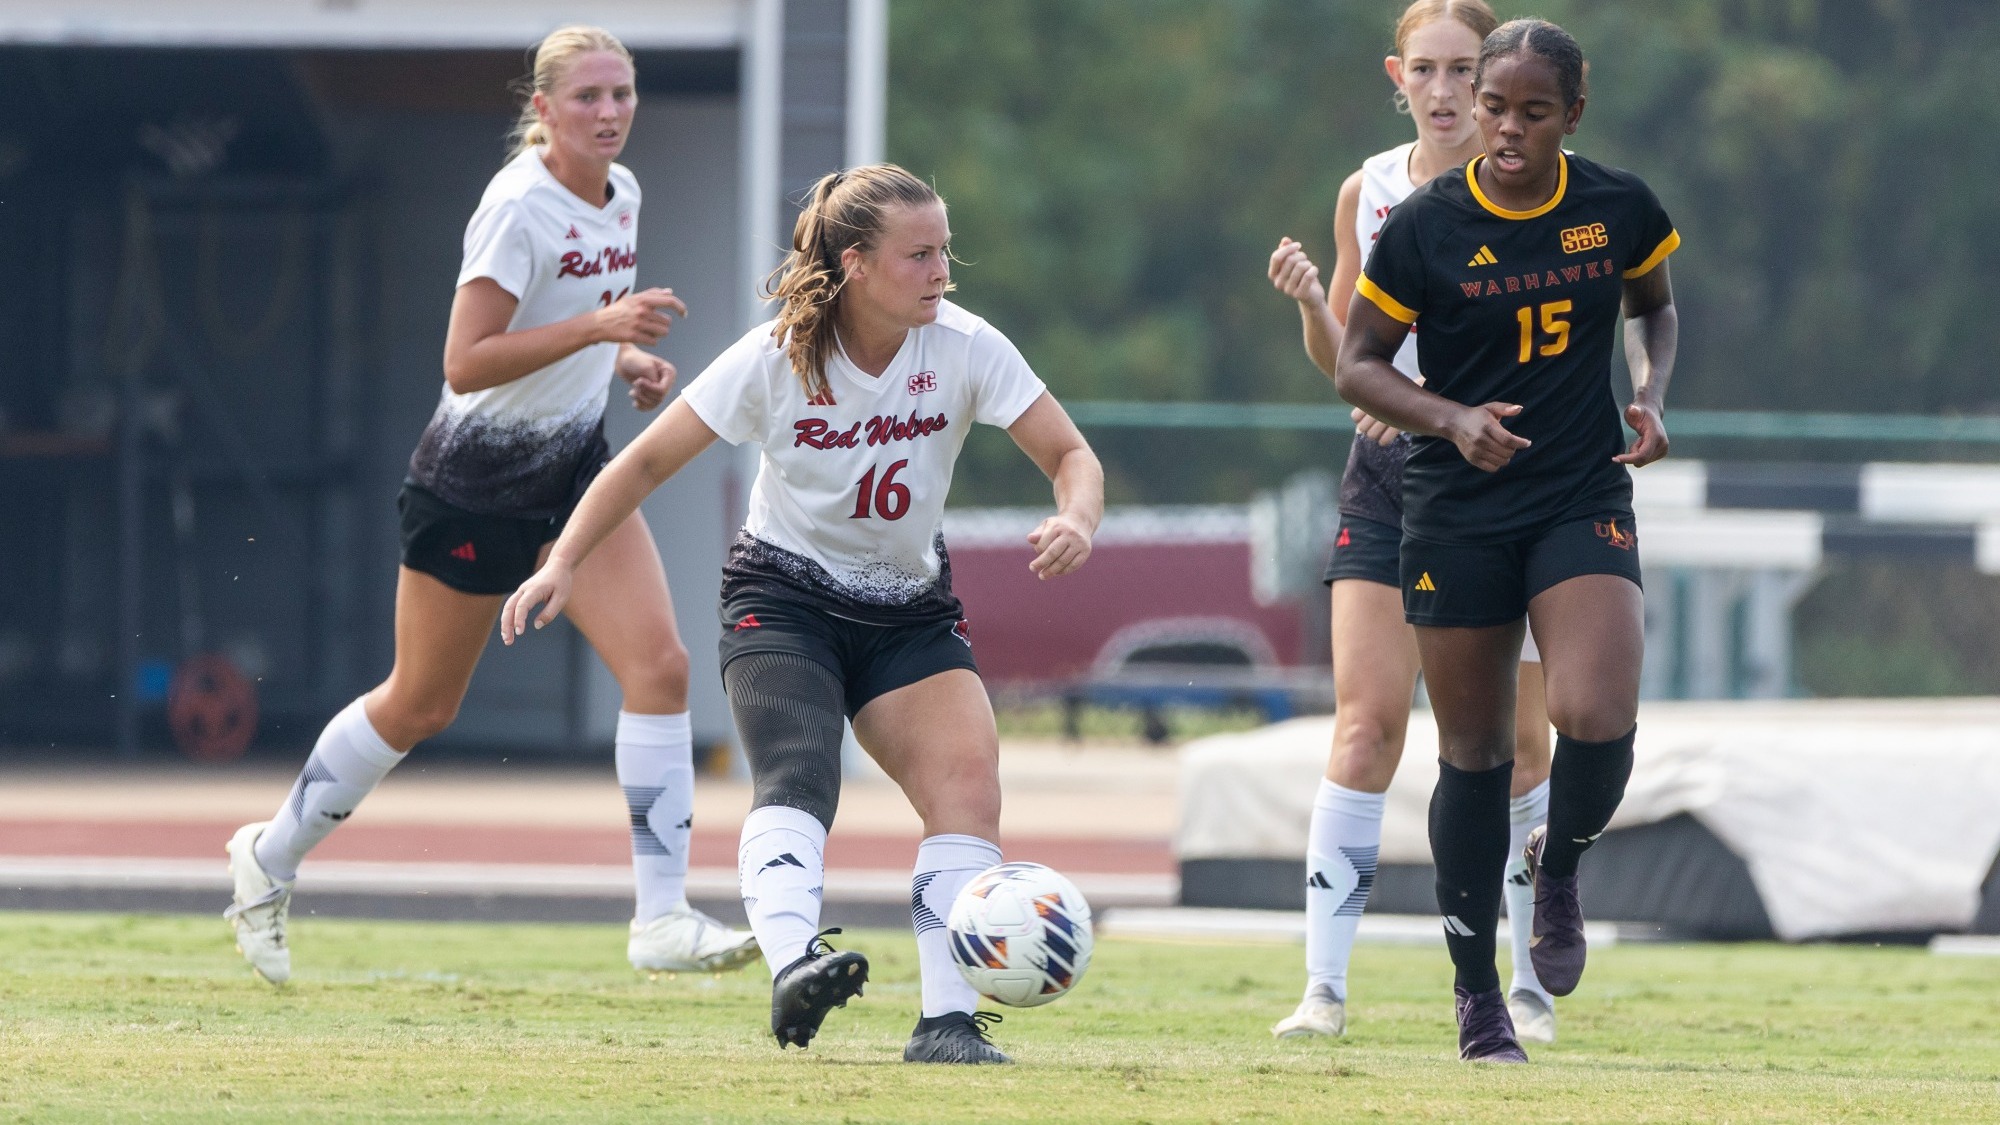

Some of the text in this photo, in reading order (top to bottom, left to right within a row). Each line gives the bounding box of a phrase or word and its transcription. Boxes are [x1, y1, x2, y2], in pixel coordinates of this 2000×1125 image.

[1561, 223, 1608, 254] SBC
[557, 250, 602, 279] Red
[1460, 259, 1614, 298] WARHAWKS
[1517, 299, 1572, 363] 15
[794, 409, 948, 450] Red Wolves
[849, 459, 911, 521] 16
